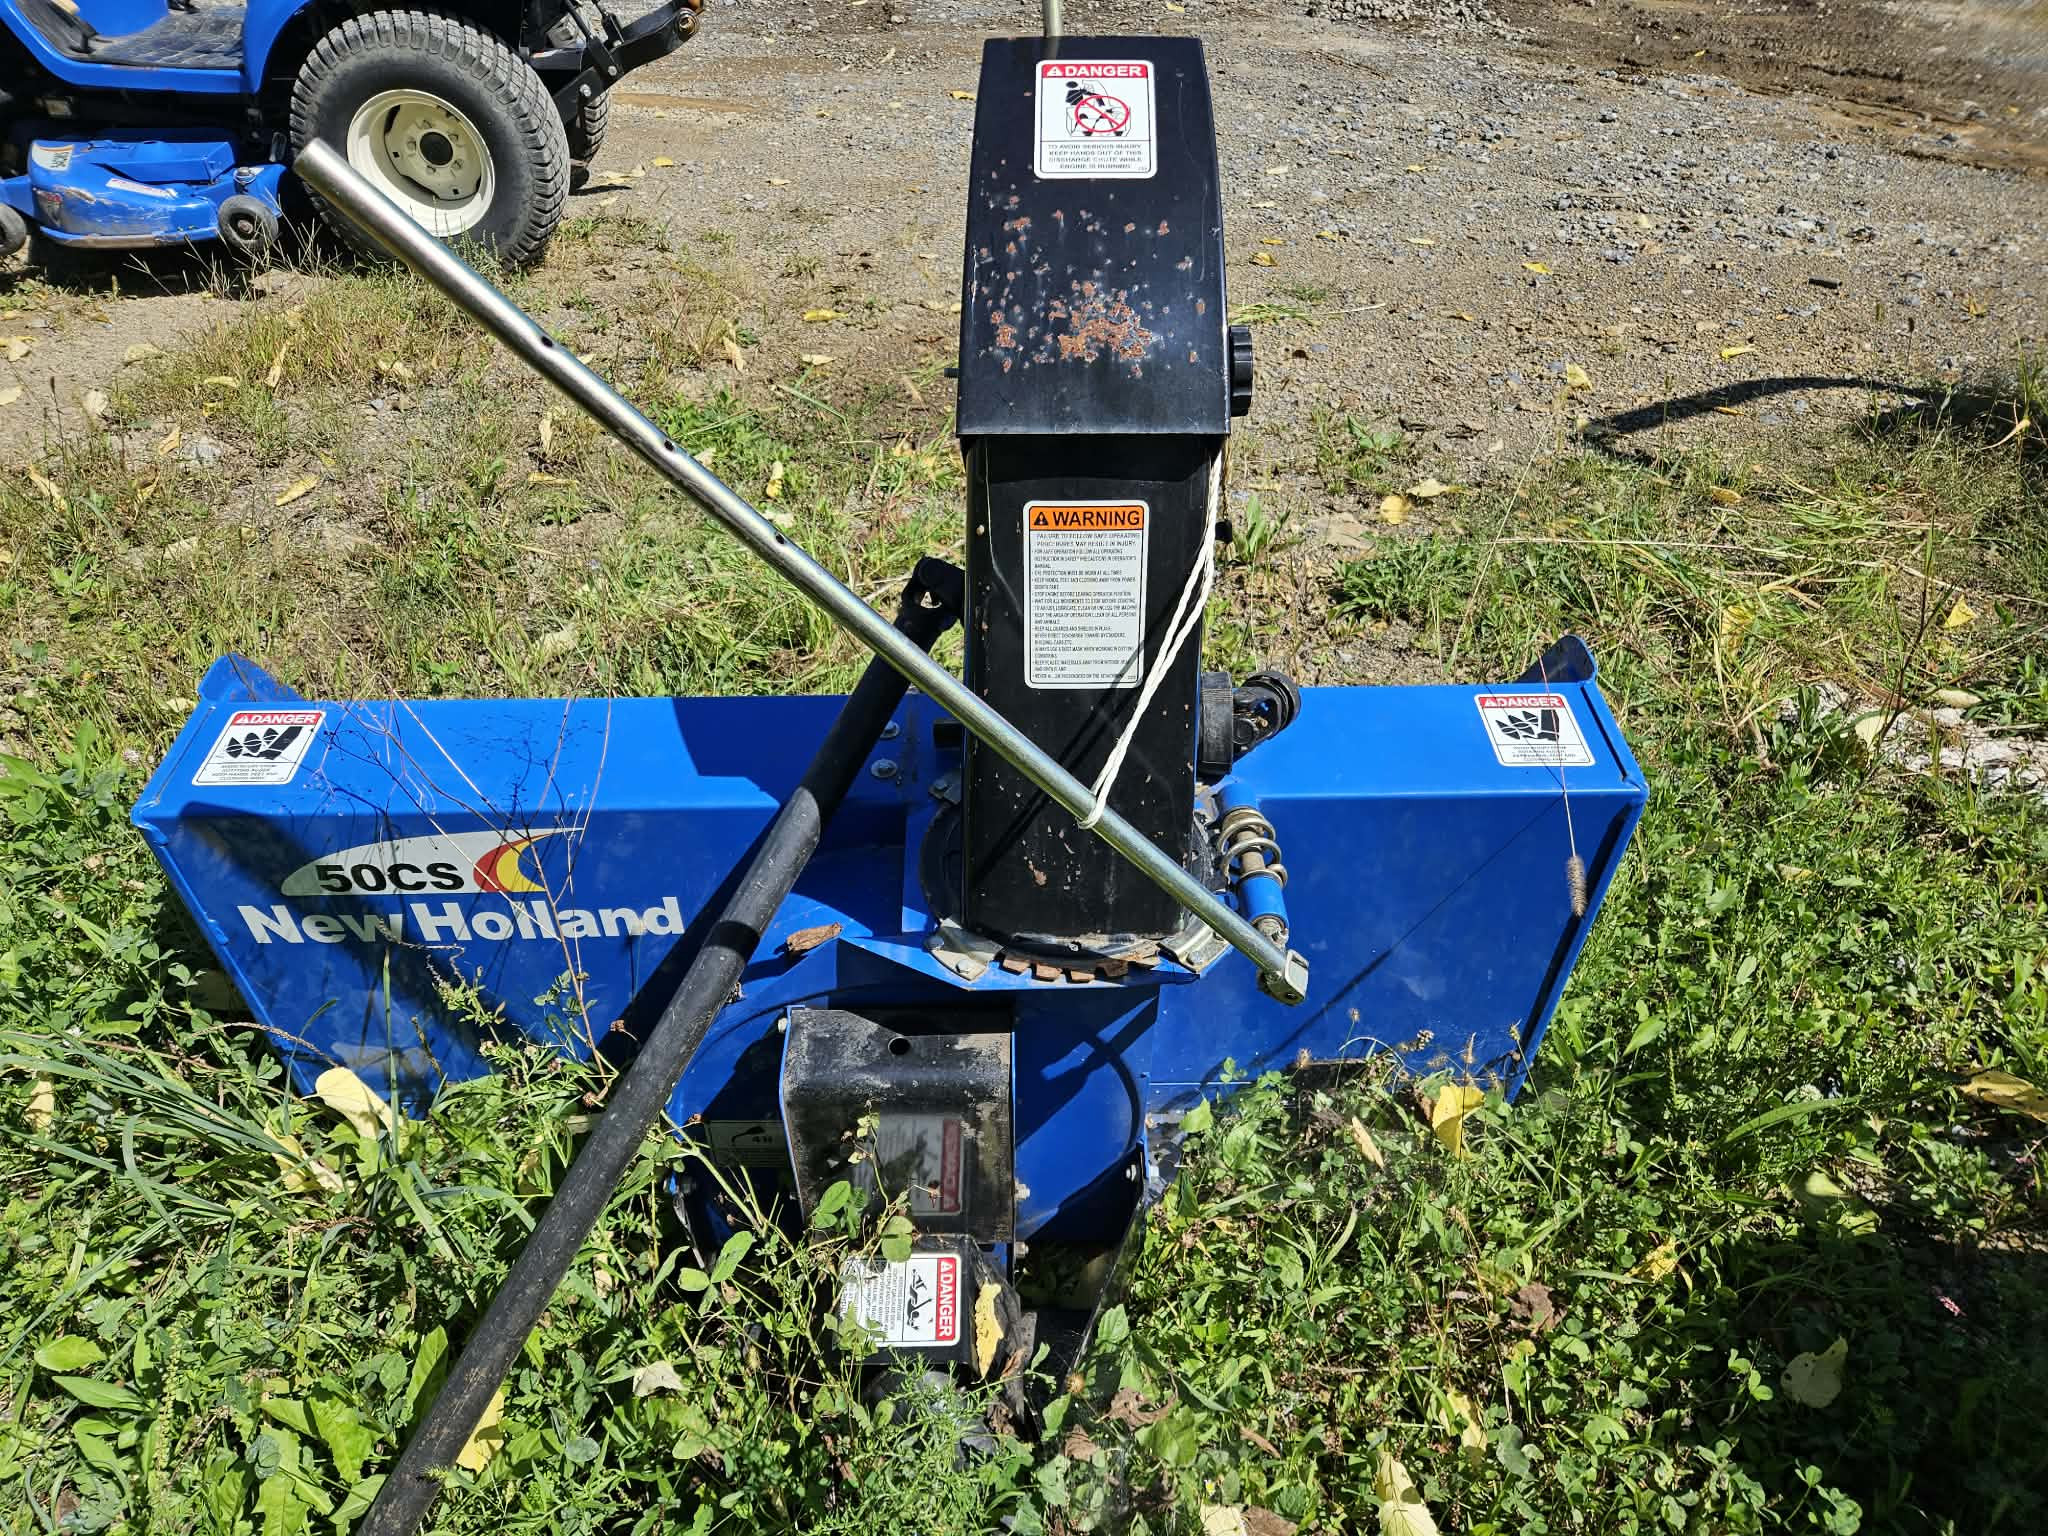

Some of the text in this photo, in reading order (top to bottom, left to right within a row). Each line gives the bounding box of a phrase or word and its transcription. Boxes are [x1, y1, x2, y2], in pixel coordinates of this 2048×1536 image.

[1065, 65, 1143, 77] DANGER
[1053, 511, 1140, 526] WARNING
[1500, 698, 1563, 707] DANGER
[252, 714, 316, 724] DANGER
[315, 862, 465, 893] 50CS
[236, 897, 684, 944] New Holland
[939, 1275, 953, 1337] DANGER
